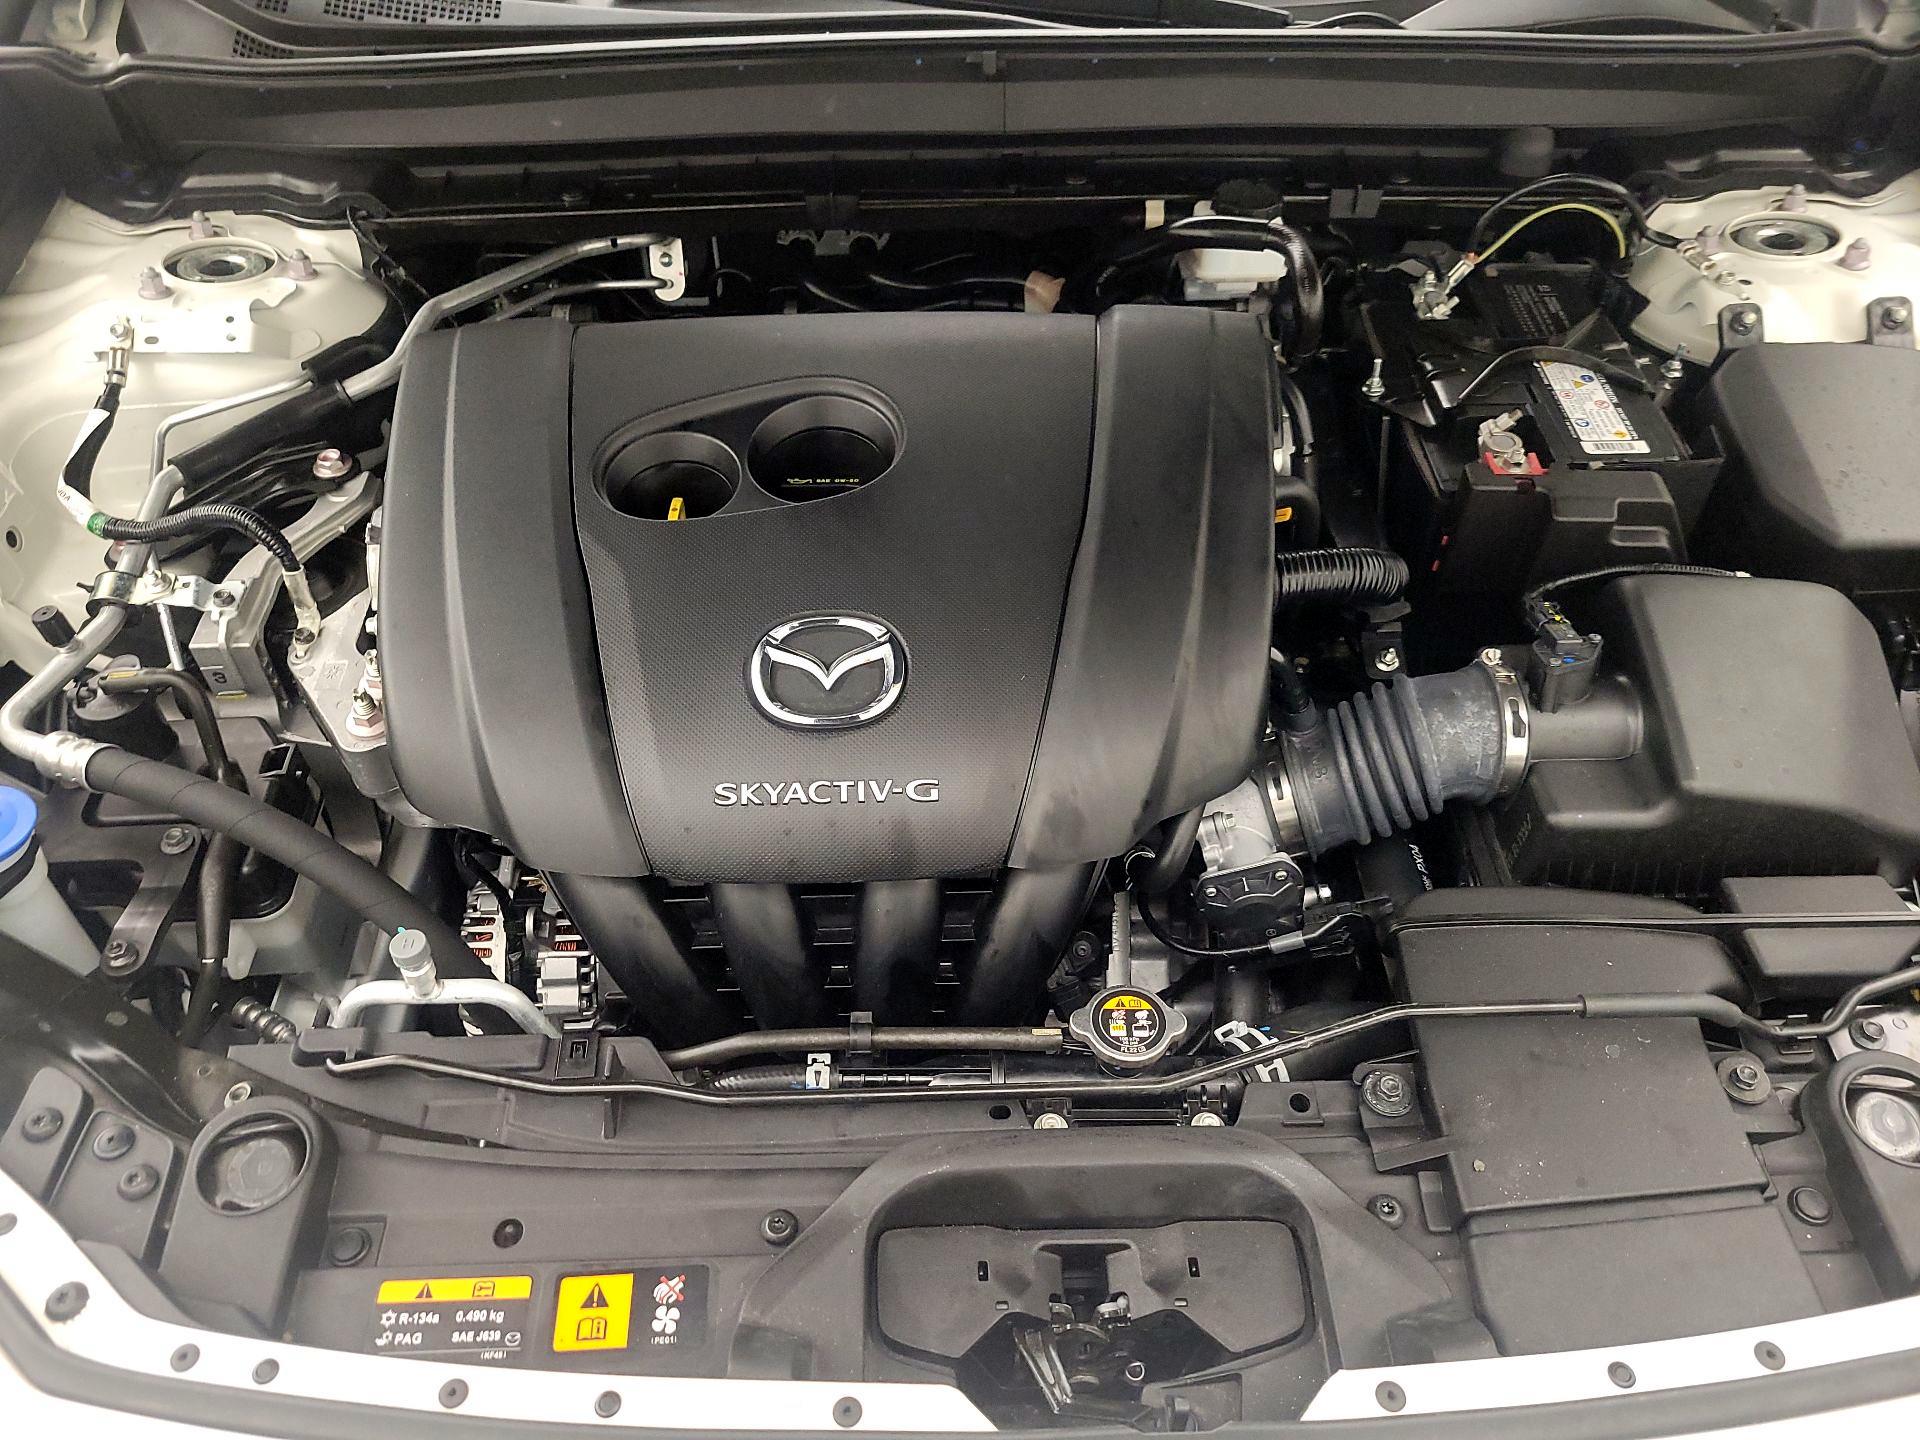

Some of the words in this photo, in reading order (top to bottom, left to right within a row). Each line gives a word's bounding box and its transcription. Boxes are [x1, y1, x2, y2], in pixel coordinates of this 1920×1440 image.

[713, 779, 940, 806] SKYACTIV-G
[398, 1311, 441, 1325] R-134a
[455, 1309, 487, 1323] 0.490
[488, 1308, 505, 1324] kg
[394, 1332, 423, 1346] PAG
[451, 1331, 475, 1343] SAE
